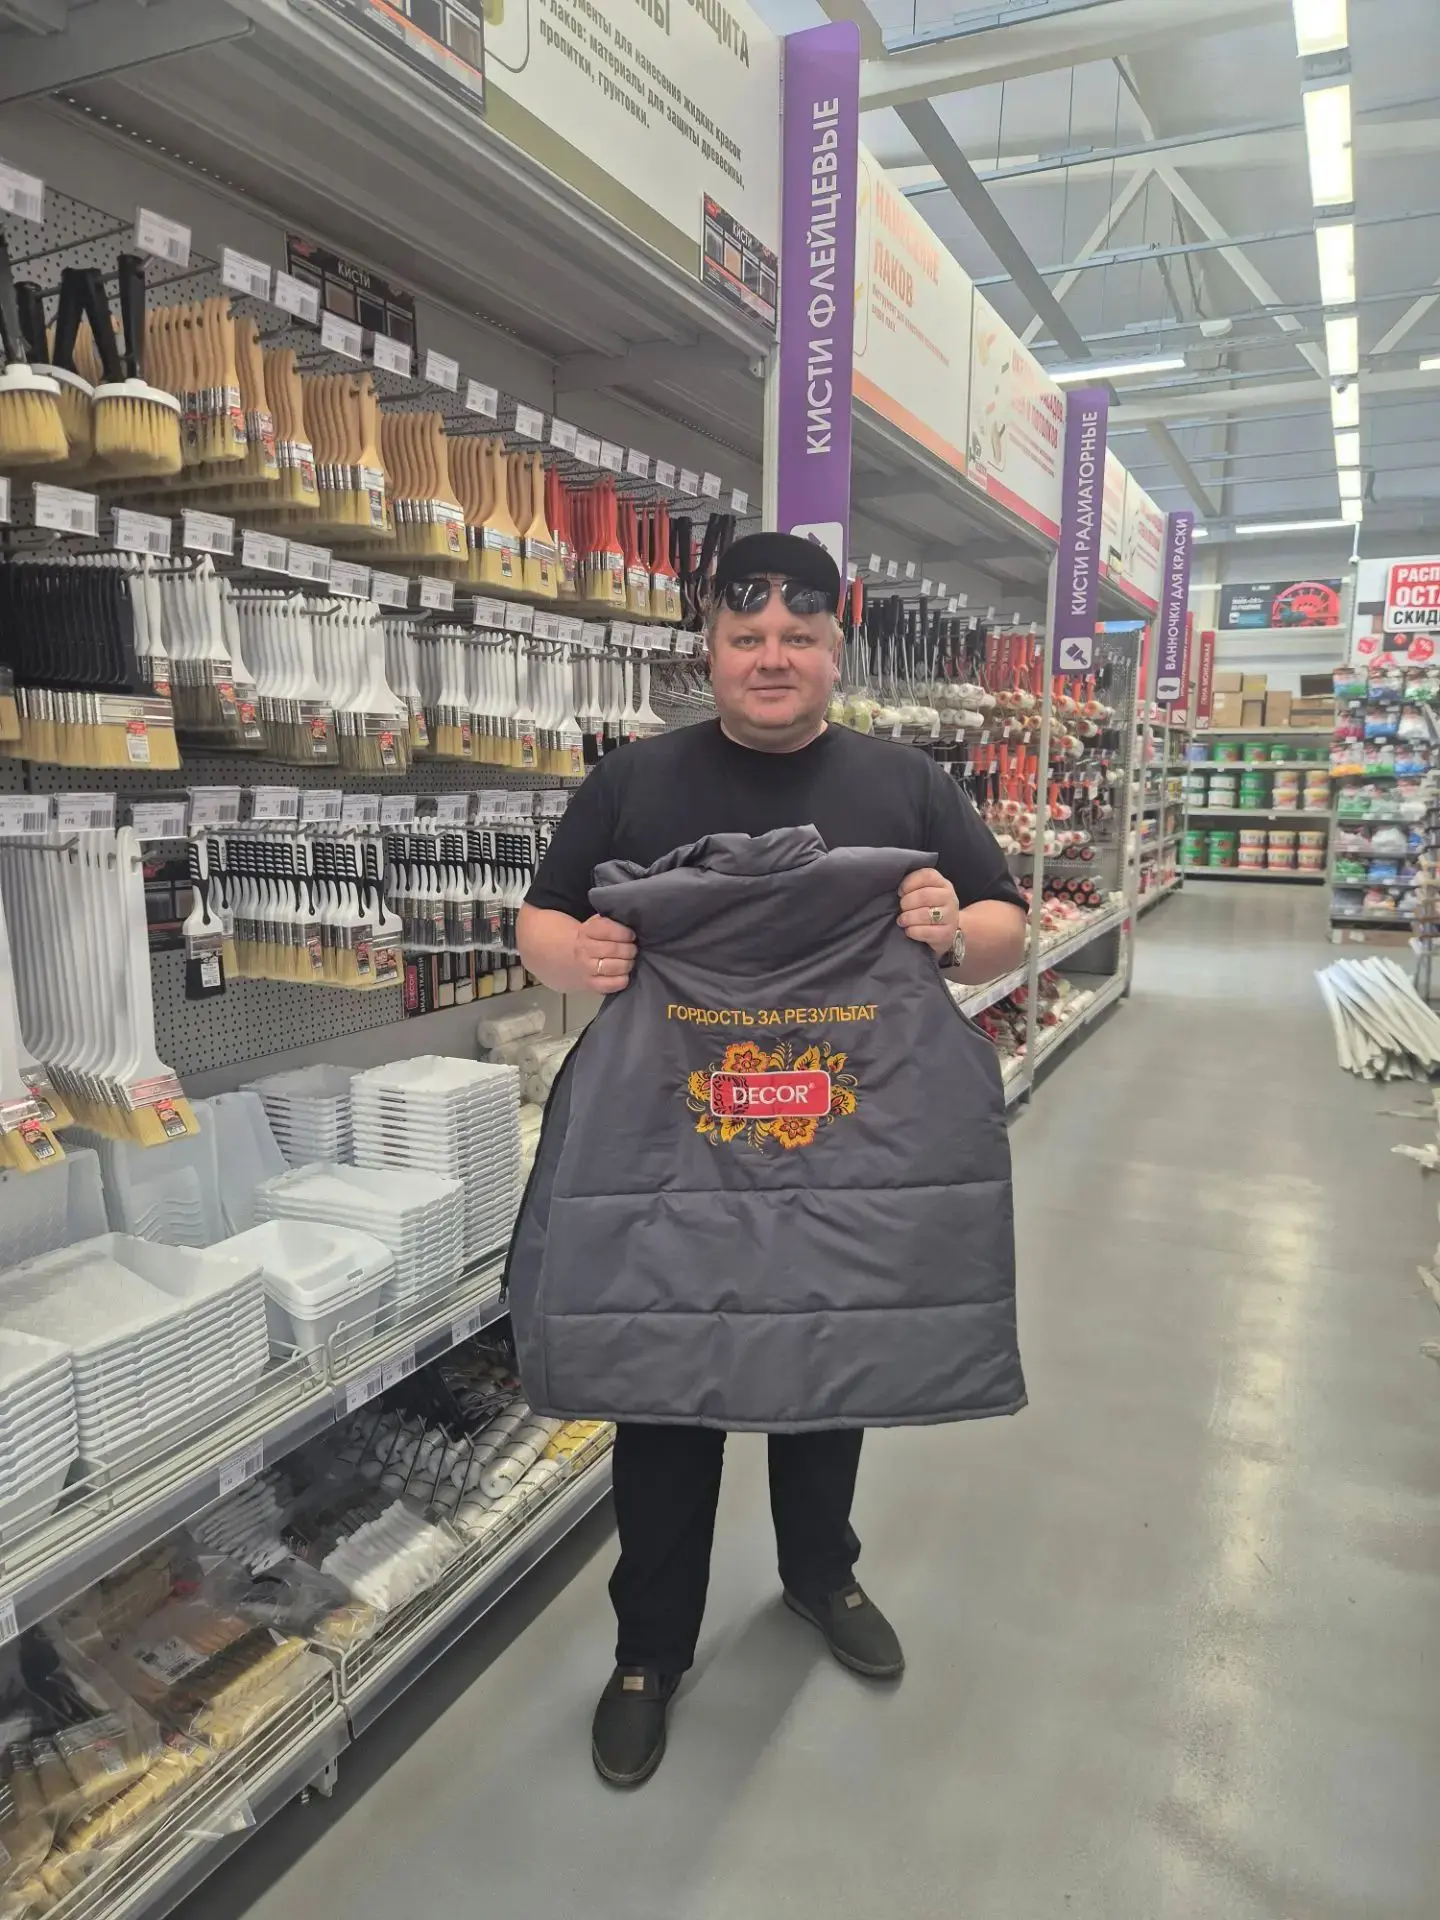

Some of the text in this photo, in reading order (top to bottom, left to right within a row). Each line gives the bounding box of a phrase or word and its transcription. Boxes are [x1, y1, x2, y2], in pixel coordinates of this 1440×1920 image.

[540, 18, 595, 84] пропитки,
[598, 70, 650, 129] грунтовки.
[550, 0, 587, 43] лаков:
[589, 34, 645, 97] материалы
[648, 88, 665, 115] для
[666, 106, 700, 148] защиты
[701, 138, 745, 191] древесины,
[567, 0, 611, 37] ументы
[614, 28, 633, 58] для
[635, 48, 681, 104] нанесения
[684, 95, 714, 136] жидких
[715, 126, 741, 162] красок
[687, 0, 749, 68] АЩИТА
[338, 260, 371, 289] КИСТИ
[806, 97, 843, 455] КИСТИ ФЛЕЙЦЕВЫЕ
[1072, 410, 1099, 616] КИСТИ РАДИАТОРНЫЕ
[1165, 518, 1189, 671] ВАННОЧКИ ДЛЯ КРАСКИ
[1393, 610, 1440, 626] СКИД
[667, 1004, 878, 1026] ГОРДОСТЬ ЗА РЕЗУЛЬТАТ
